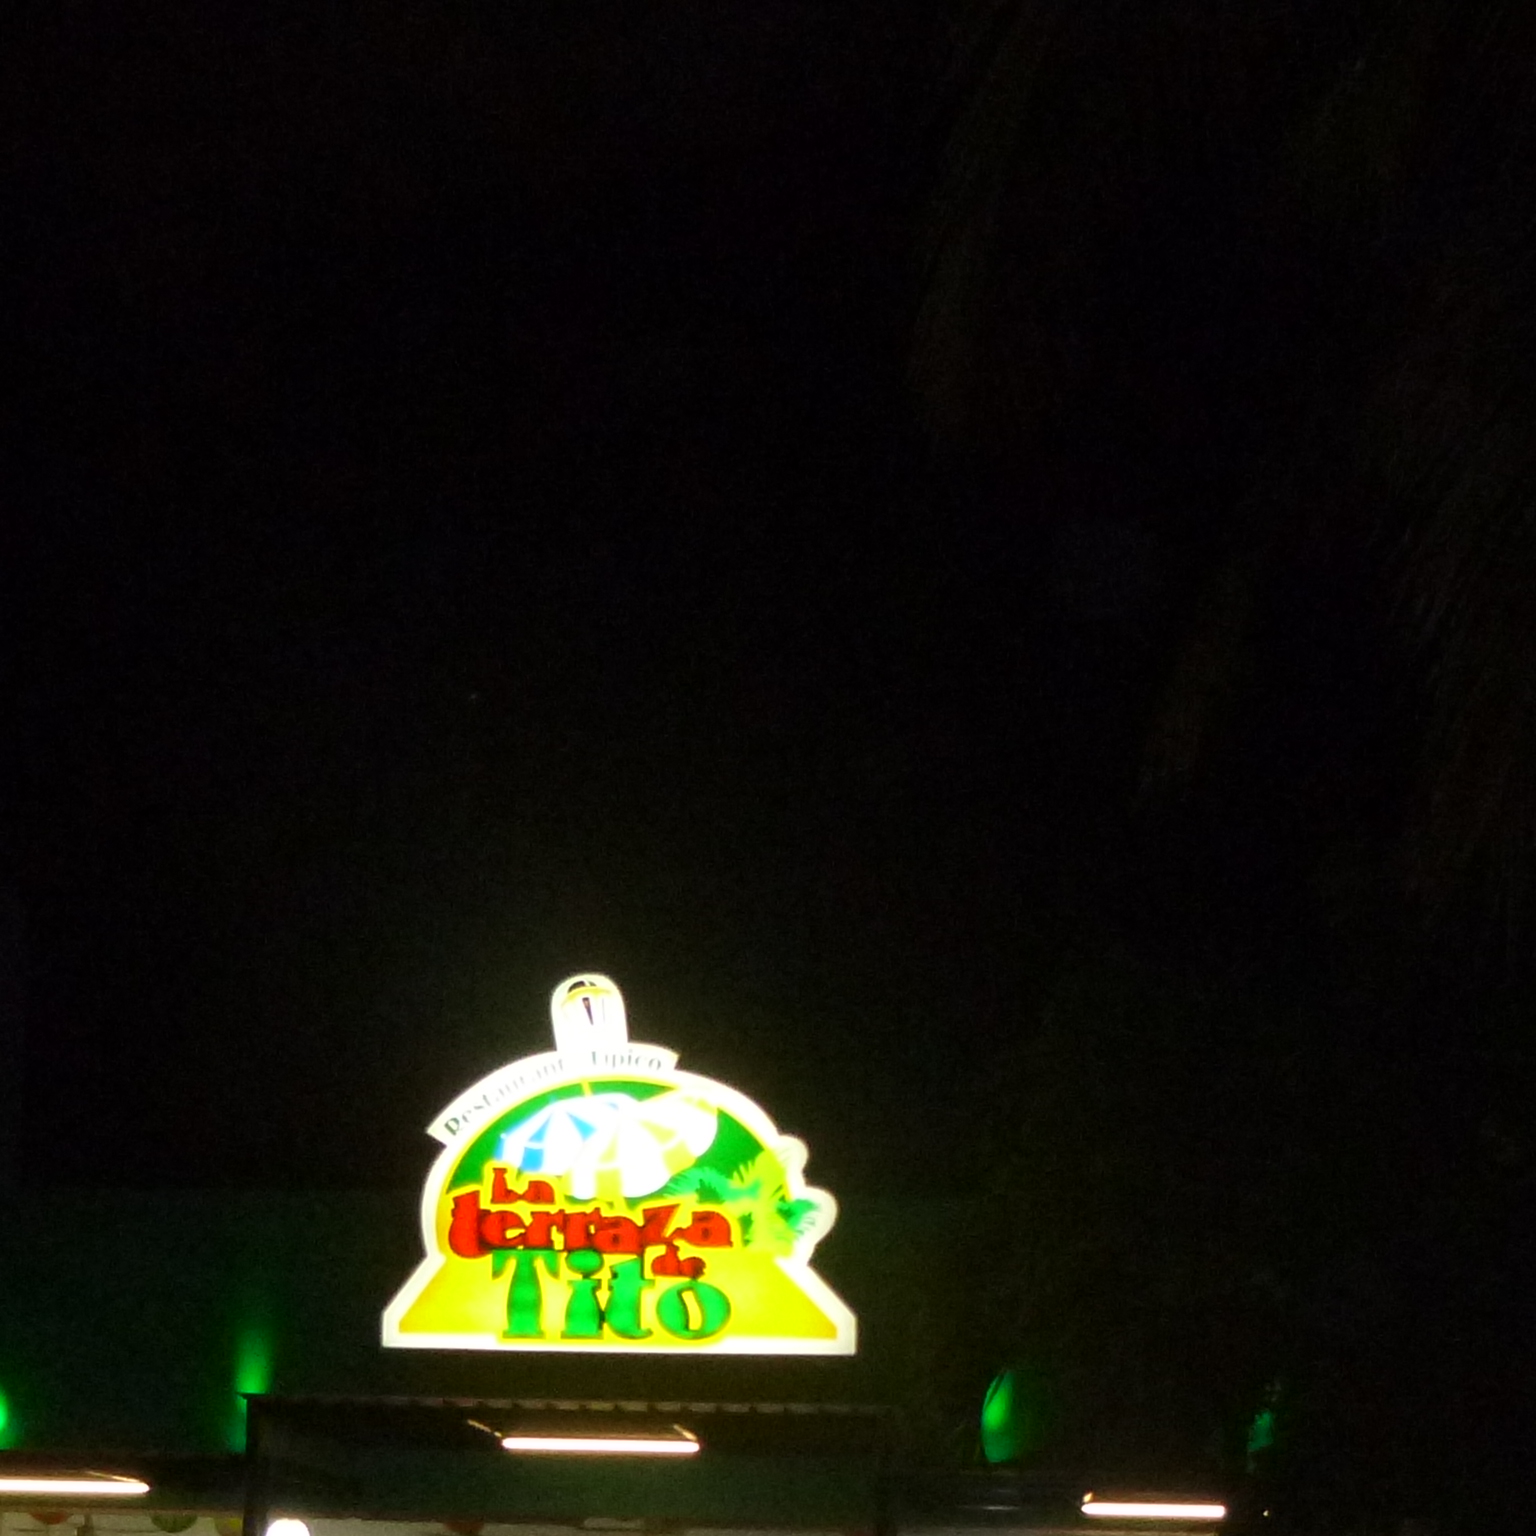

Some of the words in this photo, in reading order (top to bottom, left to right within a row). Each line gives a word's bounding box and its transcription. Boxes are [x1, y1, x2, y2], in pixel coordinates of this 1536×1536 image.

[491, 1168, 555, 1204] La
[651, 1242, 706, 1279] de
[492, 1249, 731, 1340] Tito
